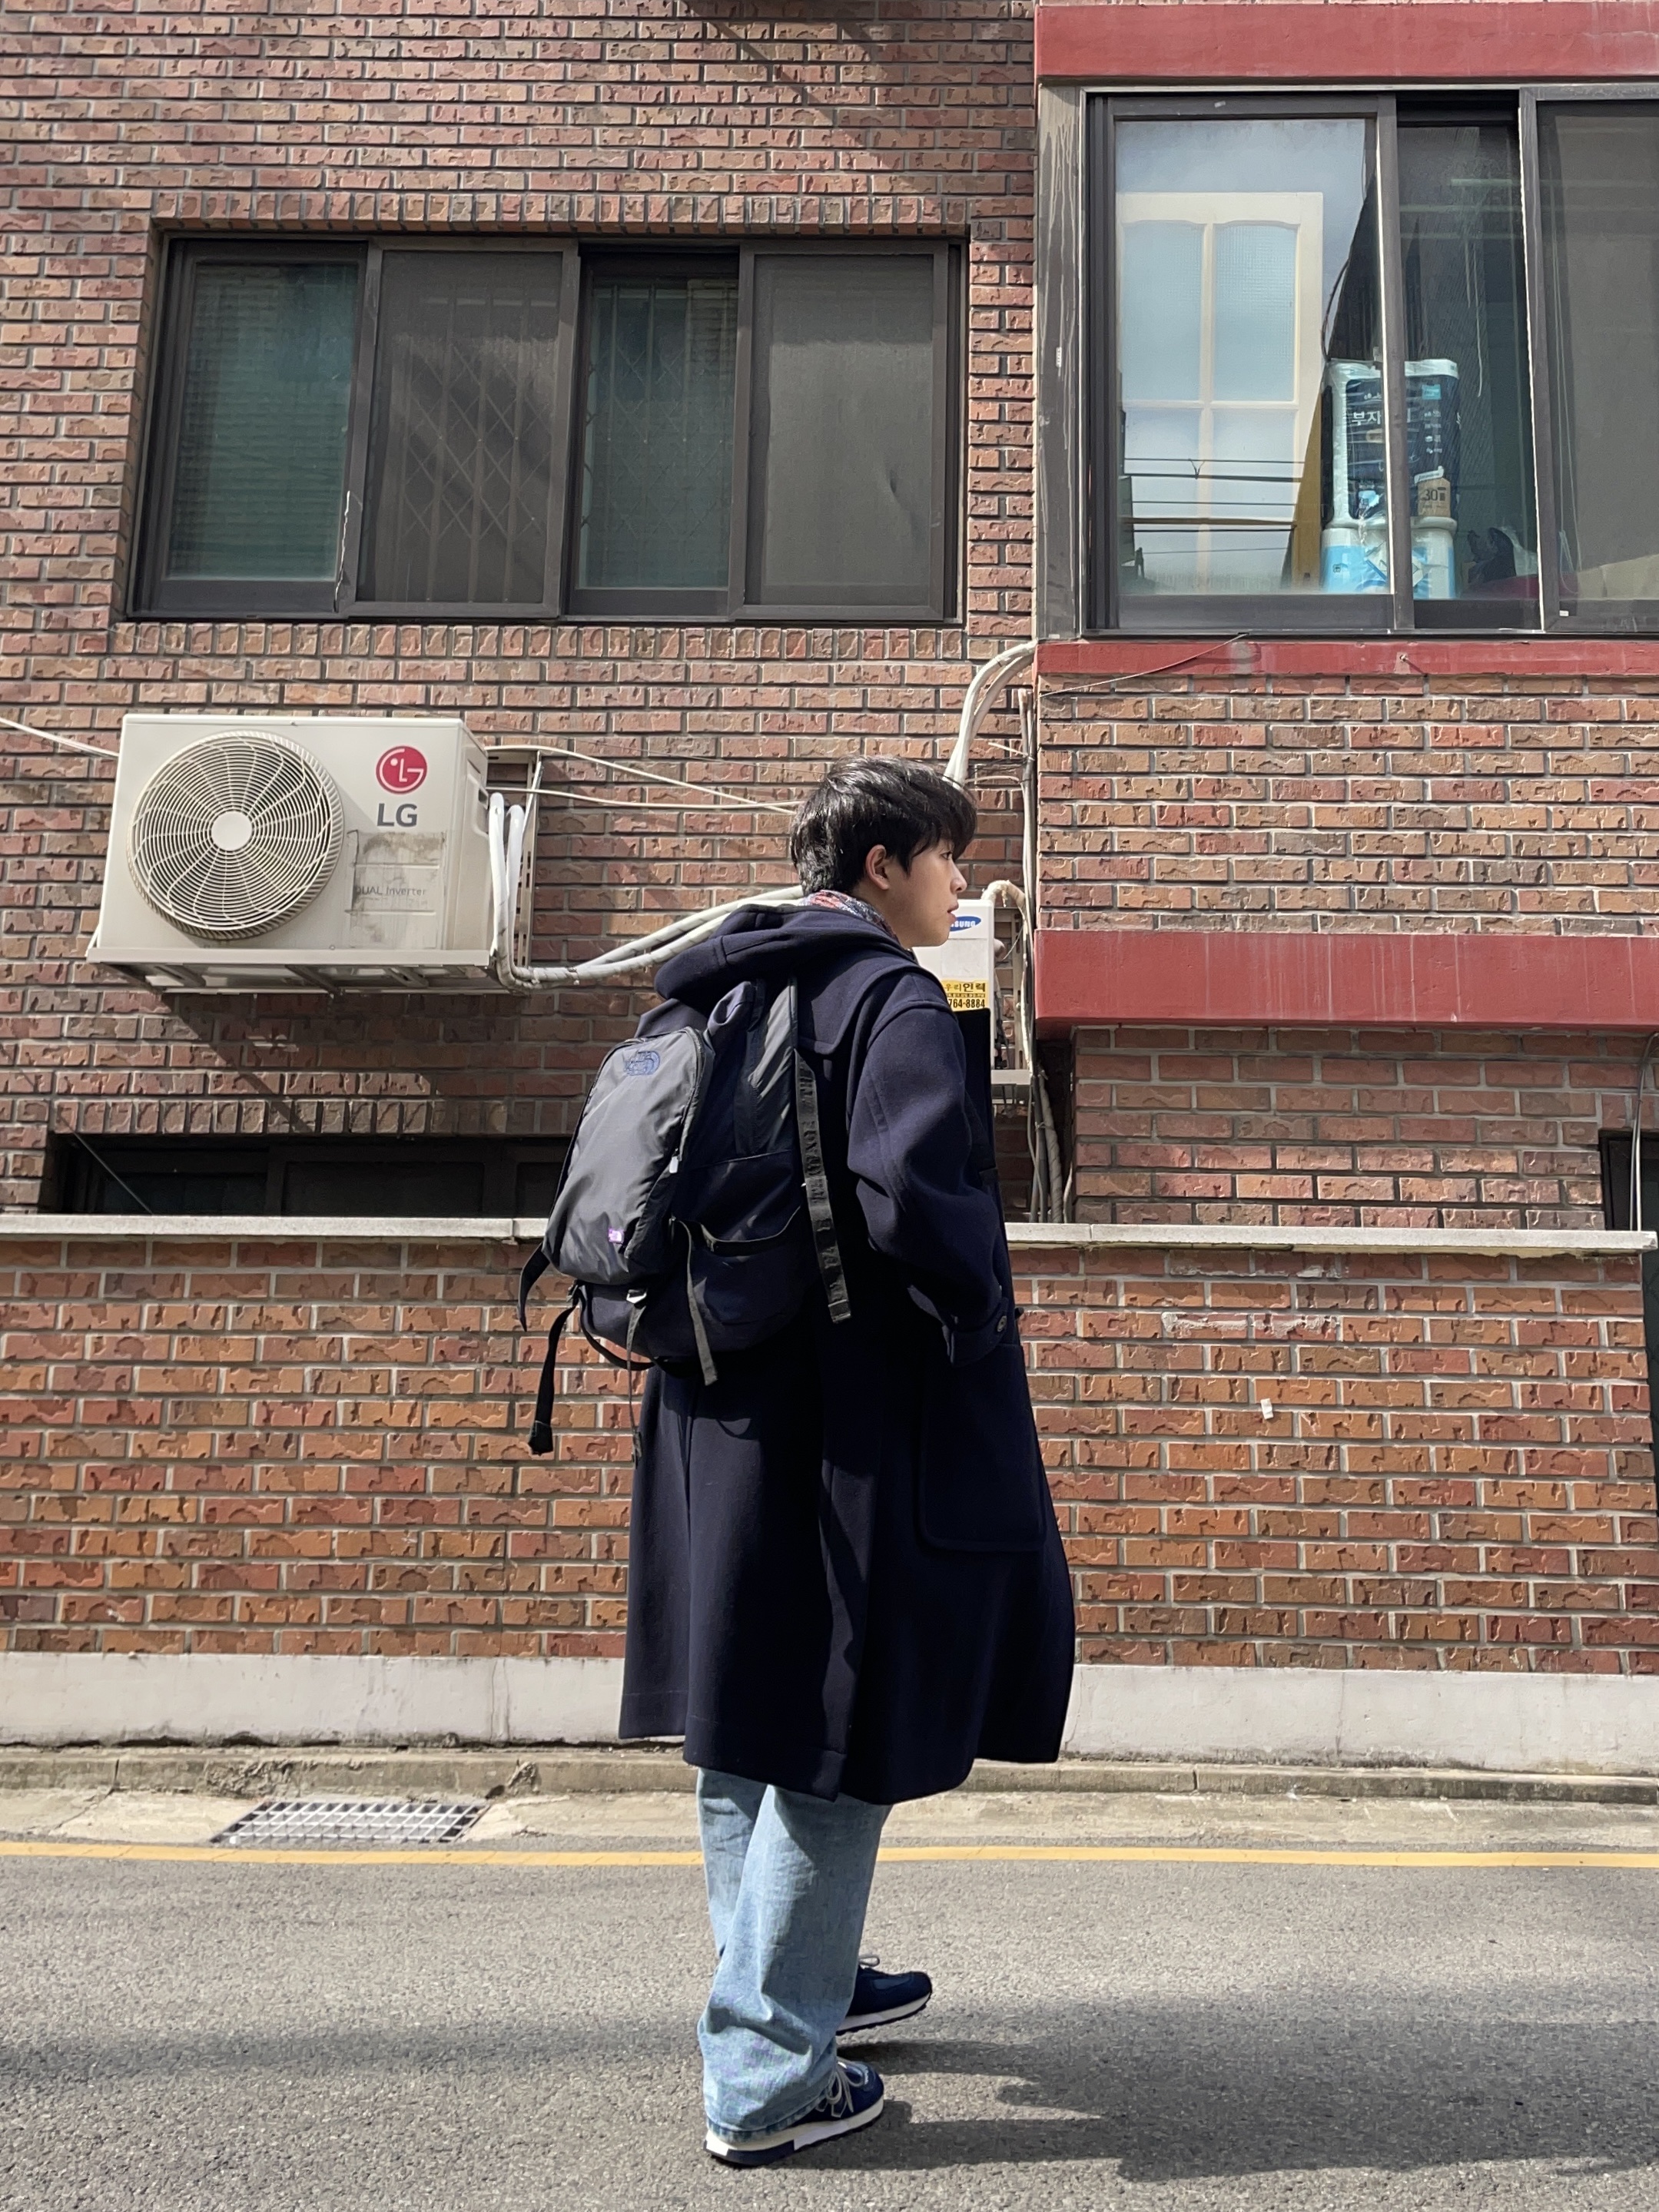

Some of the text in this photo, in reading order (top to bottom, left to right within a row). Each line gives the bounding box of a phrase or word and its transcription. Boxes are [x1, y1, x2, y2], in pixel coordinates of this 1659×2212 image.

[1422, 489, 1438, 501] 30
[377, 803, 418, 827] LG
[354, 886, 426, 897] DUAL Inverter
